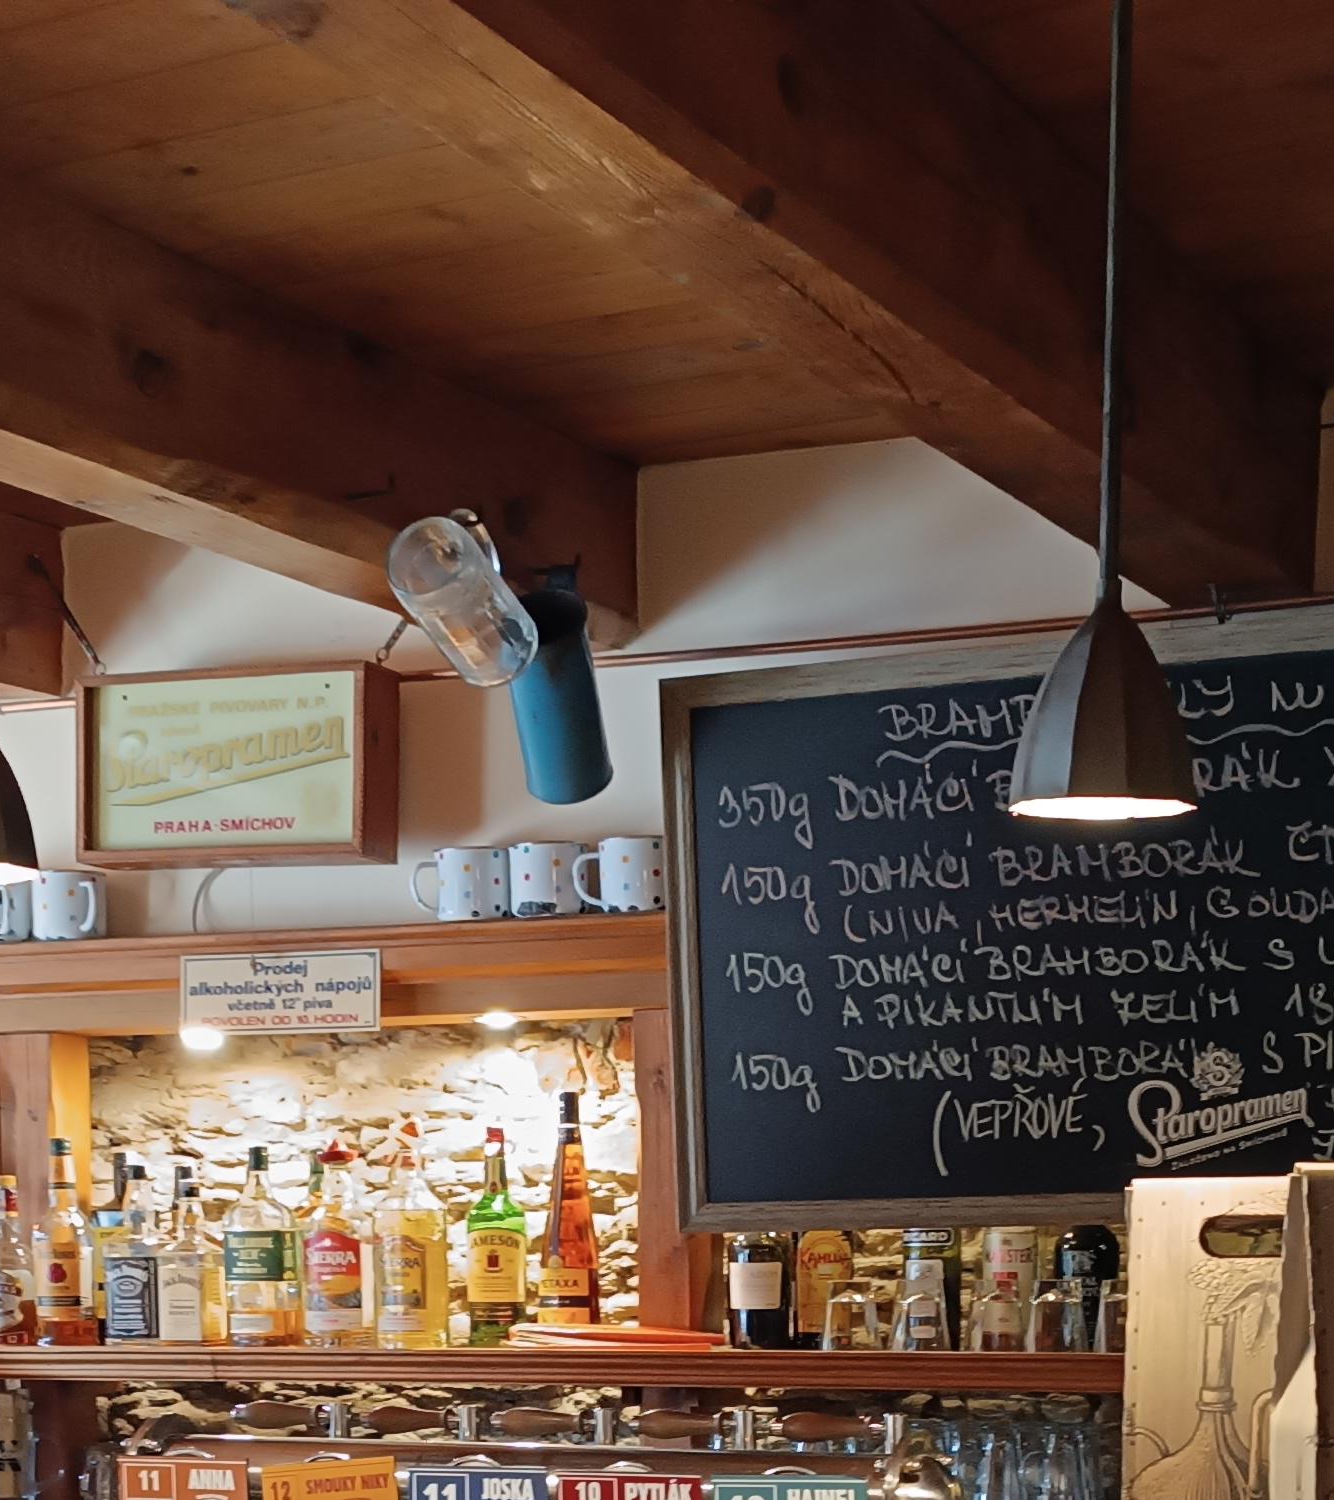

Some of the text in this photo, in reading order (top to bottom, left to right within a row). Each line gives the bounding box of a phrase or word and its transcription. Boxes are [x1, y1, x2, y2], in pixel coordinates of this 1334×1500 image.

[106, 716, 350, 793] Staropramen
[717, 782, 814, 850] 350g
[828, 760, 979, 823] DOMÁCÍ
[720, 865, 819, 935] 150g
[828, 831, 975, 897] DOMÁCÍ
[989, 826, 1261, 887] BRAMBORÁK
[253, 960, 308, 977] Prodej
[725, 952, 817, 1017] 150g
[829, 940, 969, 989] DOMÁCÍ
[983, 929, 1248, 982] BRAMBORÁK
[1263, 938, 1296, 971] S
[189, 976, 372, 997] alkoholických nápojů
[227, 997, 275, 1011] včetně
[303, 997, 333, 1011] piva
[840, 994, 864, 1029] A
[201, 1015, 265, 1026] POVOLEN
[272, 1015, 291, 1025] OD
[314, 1013, 359, 1024] HODIN
[730, 1051, 821, 1114] 150g
[835, 1037, 979, 1083] DOMÁCÍ
[1261, 1033, 1286, 1075] S
[1127, 1079, 1315, 1168] Staropramen
[306, 1250, 357, 1266] SIERRA
[137, 1469, 236, 1491] 11 ANNA
[481, 1478, 534, 1500] JOSKA
